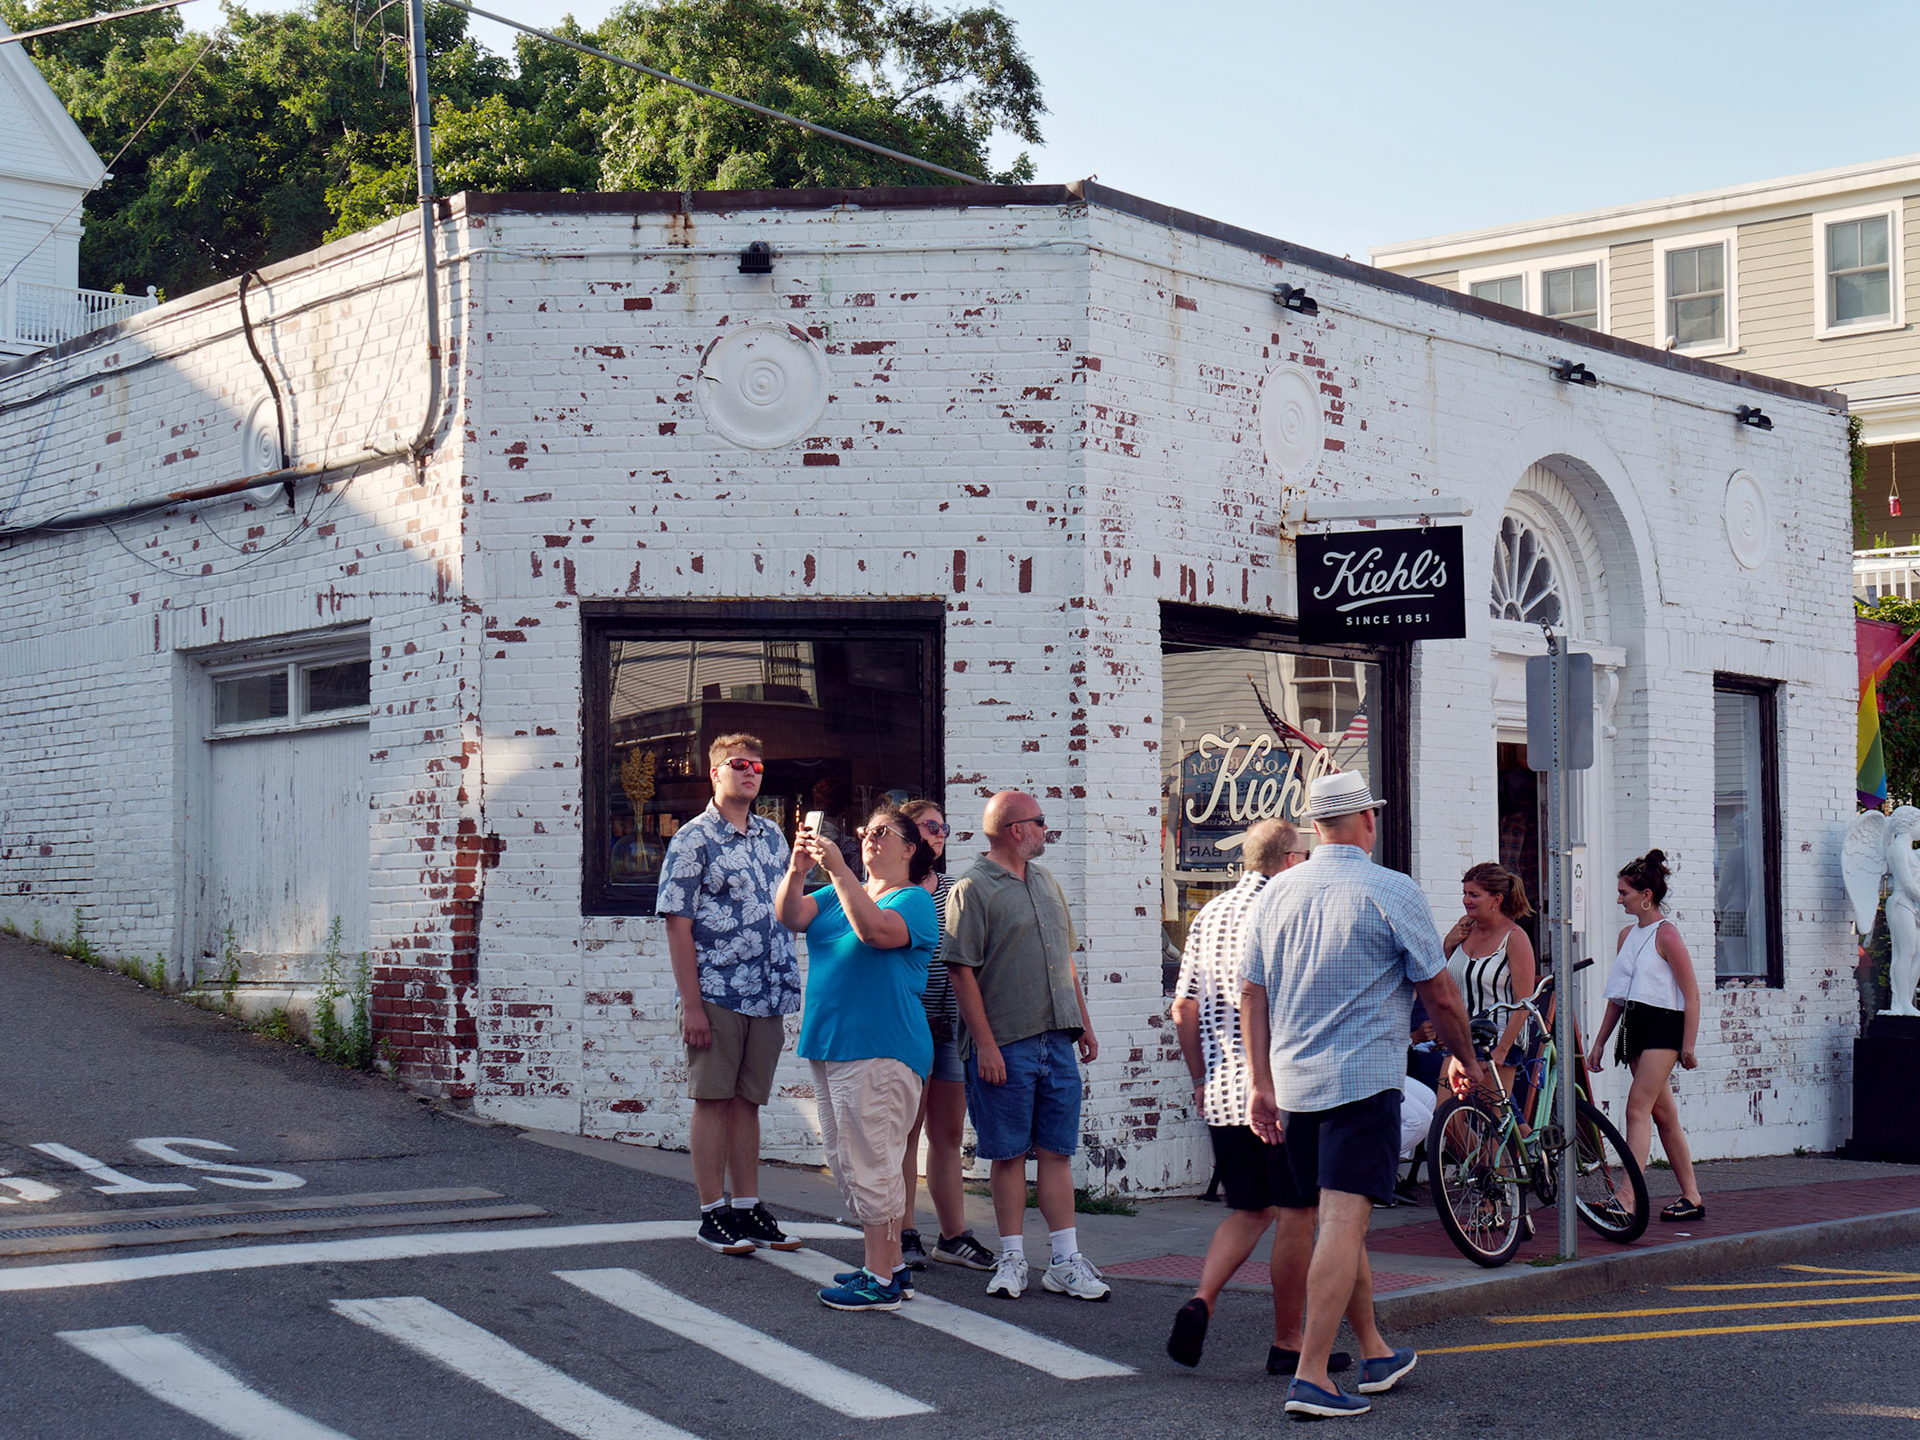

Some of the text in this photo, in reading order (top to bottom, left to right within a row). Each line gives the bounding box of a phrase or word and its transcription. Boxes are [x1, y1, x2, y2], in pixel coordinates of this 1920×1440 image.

[1313, 547, 1447, 600] Kiehl's
[1346, 613, 1431, 626] SINCE 1851
[1186, 733, 1337, 824] Kiehl'
